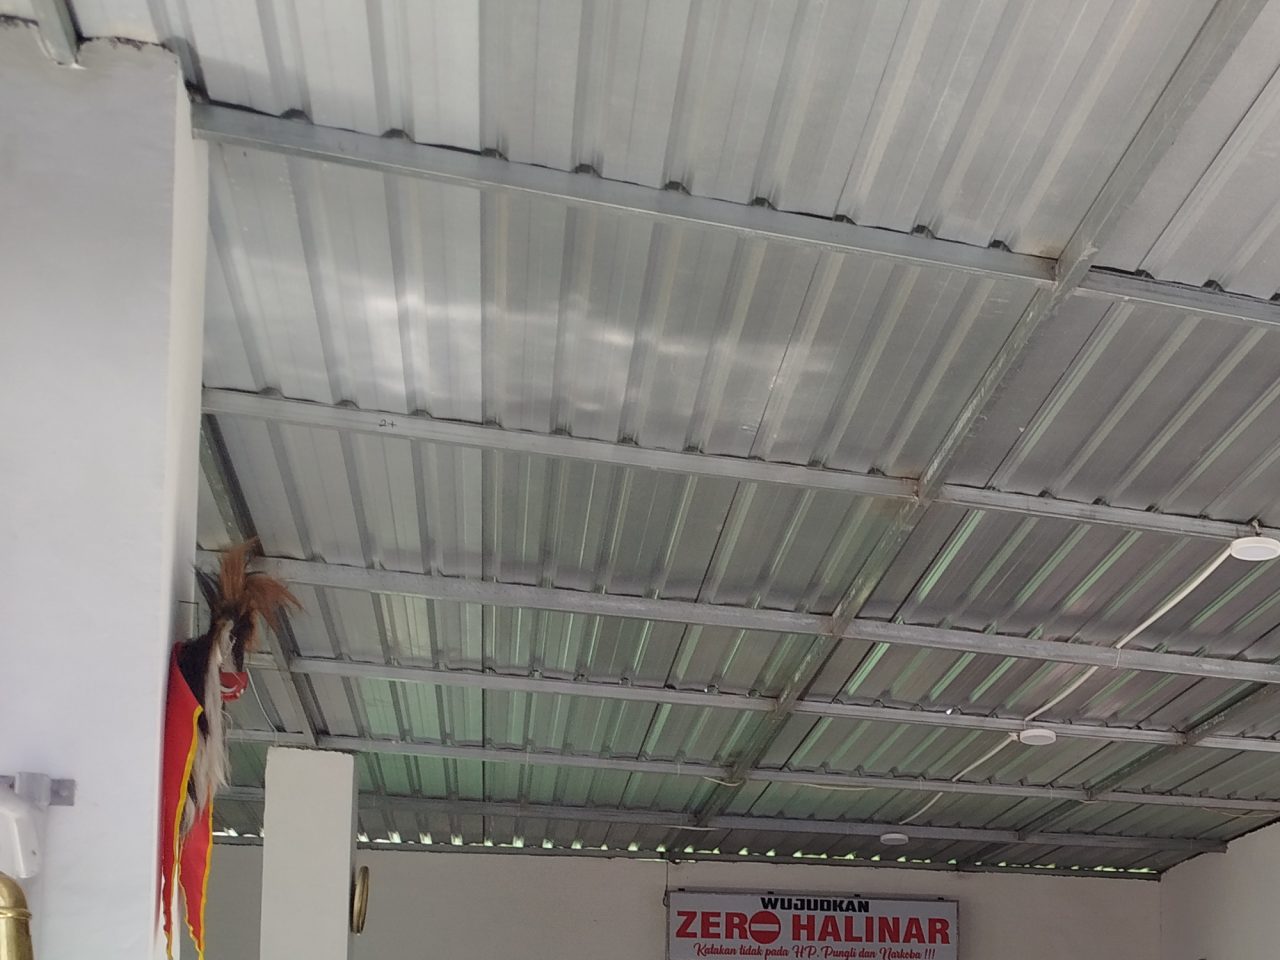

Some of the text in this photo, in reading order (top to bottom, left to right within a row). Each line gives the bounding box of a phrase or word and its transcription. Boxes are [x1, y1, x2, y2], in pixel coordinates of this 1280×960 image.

[760, 897, 870, 913] WUJUDKAN
[792, 914, 951, 944] HALINAR
[693, 943, 737, 957] Katakan
[739, 944, 762, 956] tidak
[764, 945, 789, 960] pada
[858, 947, 877, 959] dan
[879, 947, 922, 960] Narkoba
